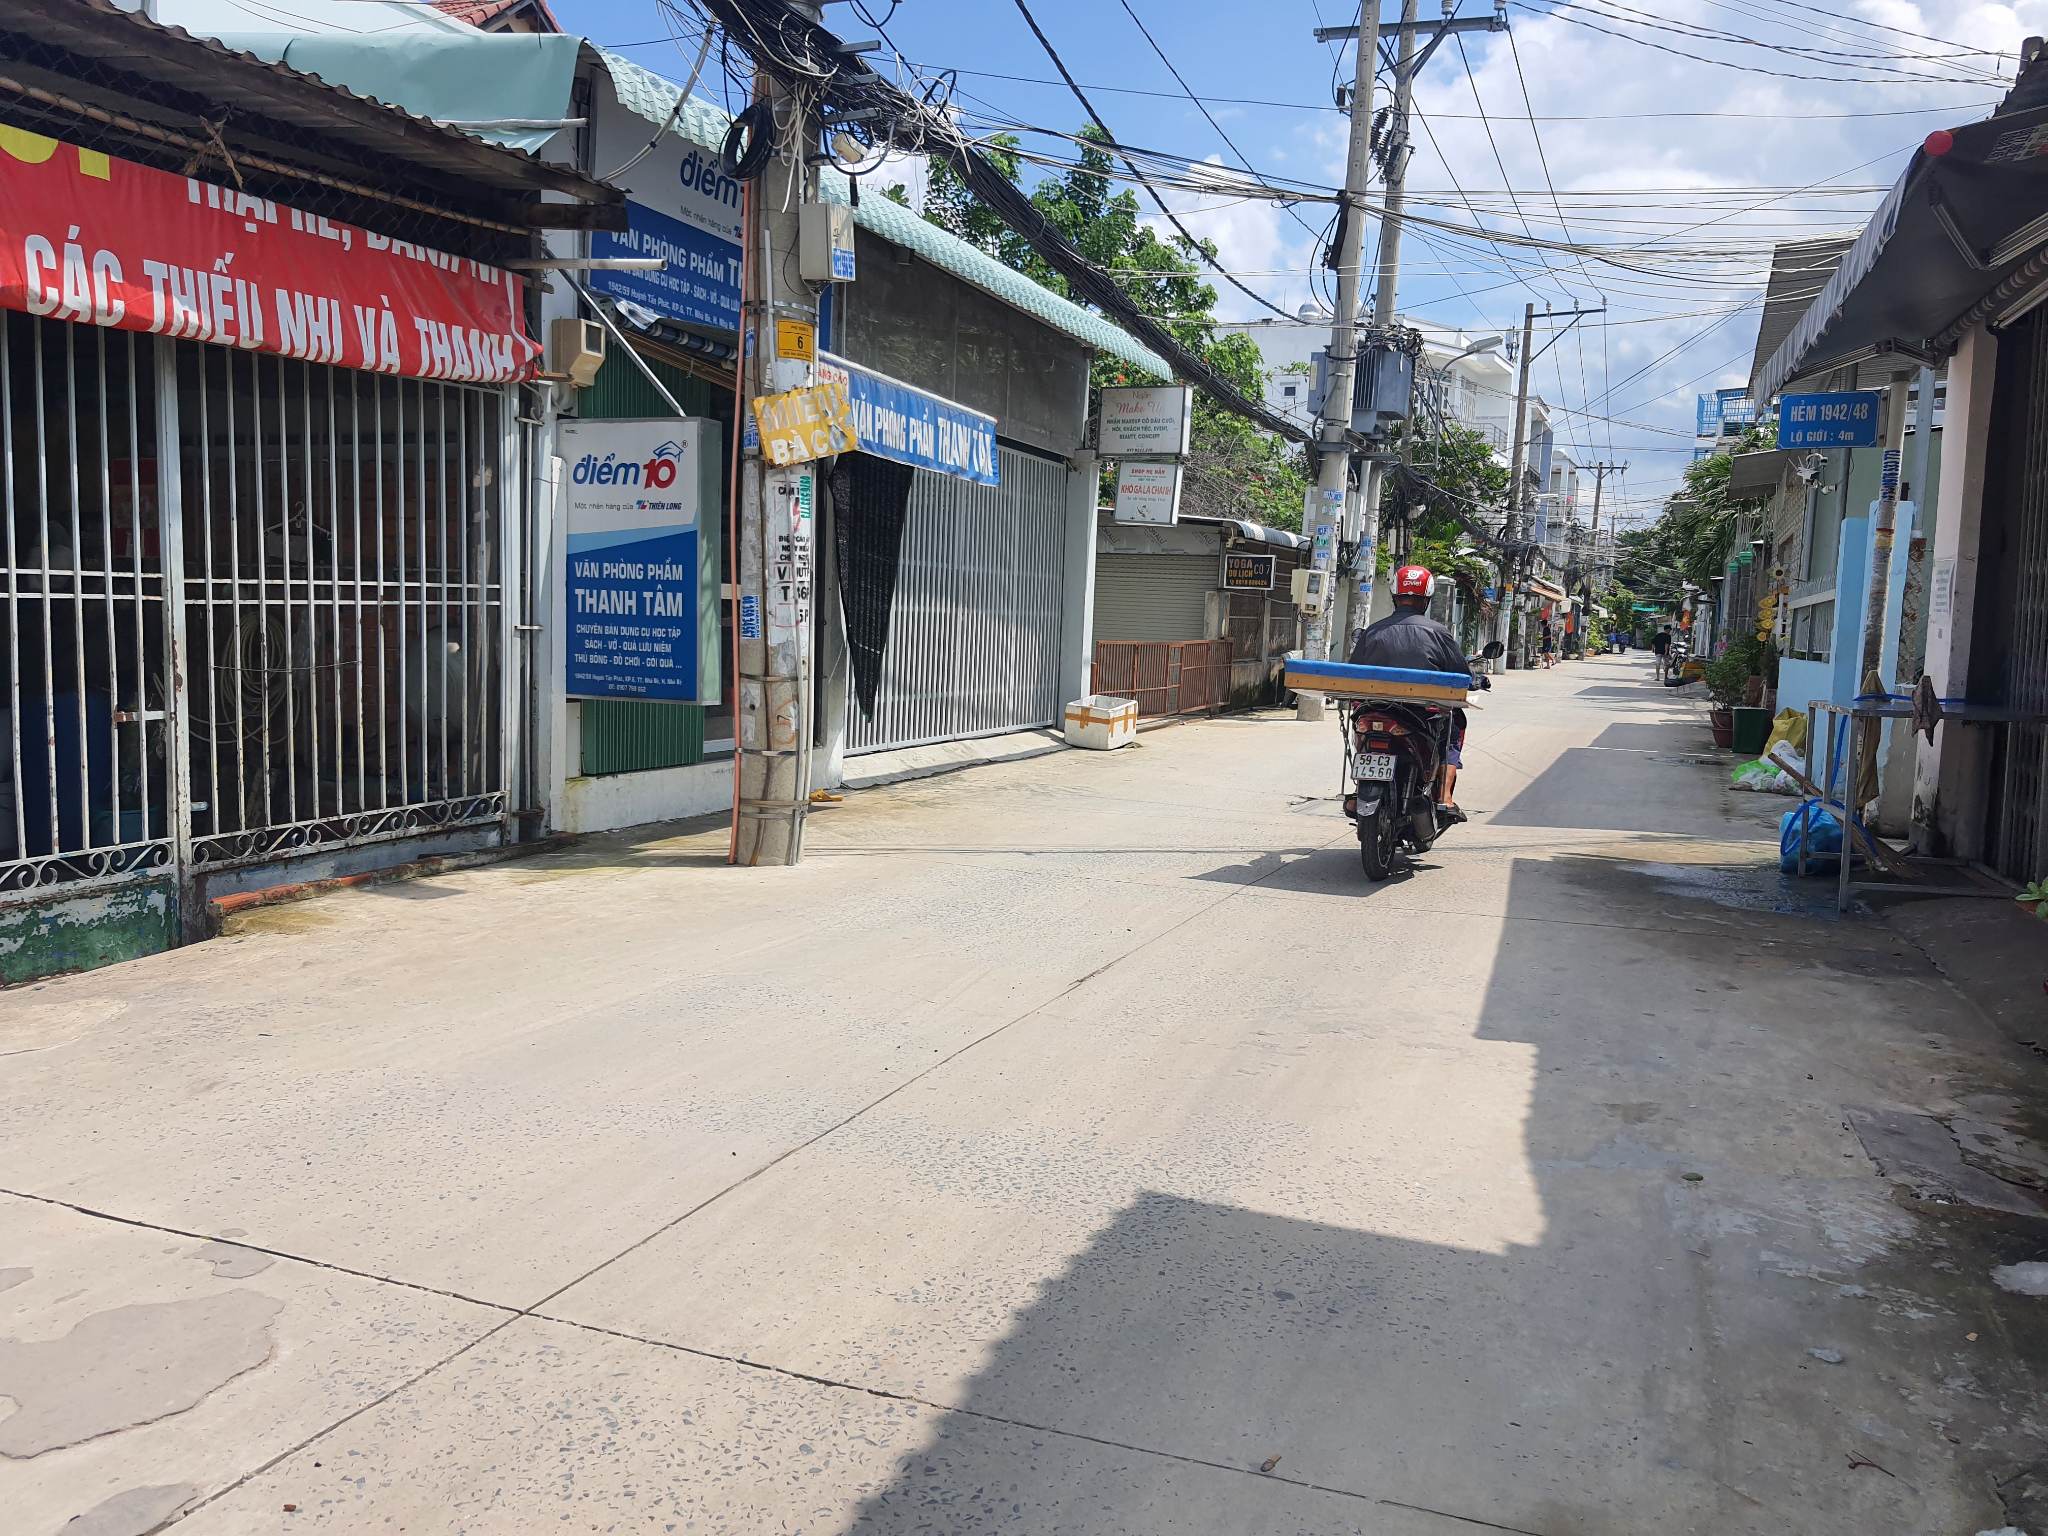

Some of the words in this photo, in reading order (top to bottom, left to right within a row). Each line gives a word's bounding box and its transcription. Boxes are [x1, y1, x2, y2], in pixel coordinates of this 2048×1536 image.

[680, 150, 738, 208] điểm
[643, 235, 687, 268] PHÒNG
[690, 251, 724, 283] PHẨM
[24, 224, 125, 327] CÁC
[142, 251, 264, 350] THIẾU
[275, 287, 344, 364] NHI
[355, 294, 401, 372] VÀ
[413, 316, 514, 383] THANH
[797, 335, 804, 349] 6
[1790, 400, 1816, 422] HẺM
[1820, 402, 1869, 422] 1942/48
[852, 391, 874, 442] VĂN
[875, 401, 907, 453] PHÒNG
[937, 416, 971, 471] THANH
[1790, 431, 1802, 444] LỘ
[1838, 430, 1854, 441] 4m
[575, 559, 599, 578] VĂN
[603, 558, 644, 580] PHÒNG
[648, 557, 682, 580] PHẨM
[575, 588, 636, 615] THANH
[643, 584, 682, 617] TÂM
[576, 623, 602, 635] CHUYÊN
[605, 624, 618, 636] BÁN
[621, 627, 639, 639] DỤNG
[641, 628, 650, 640] CỤ
[652, 628, 666, 640] HỌC
[668, 626, 681, 641] TẬP
[585, 638, 602, 649] SÁCH
[654, 640, 672, 655] NIỆM
[1360, 755, 1390, 766] 59-C3
[1355, 767, 1392, 778] 145.60
